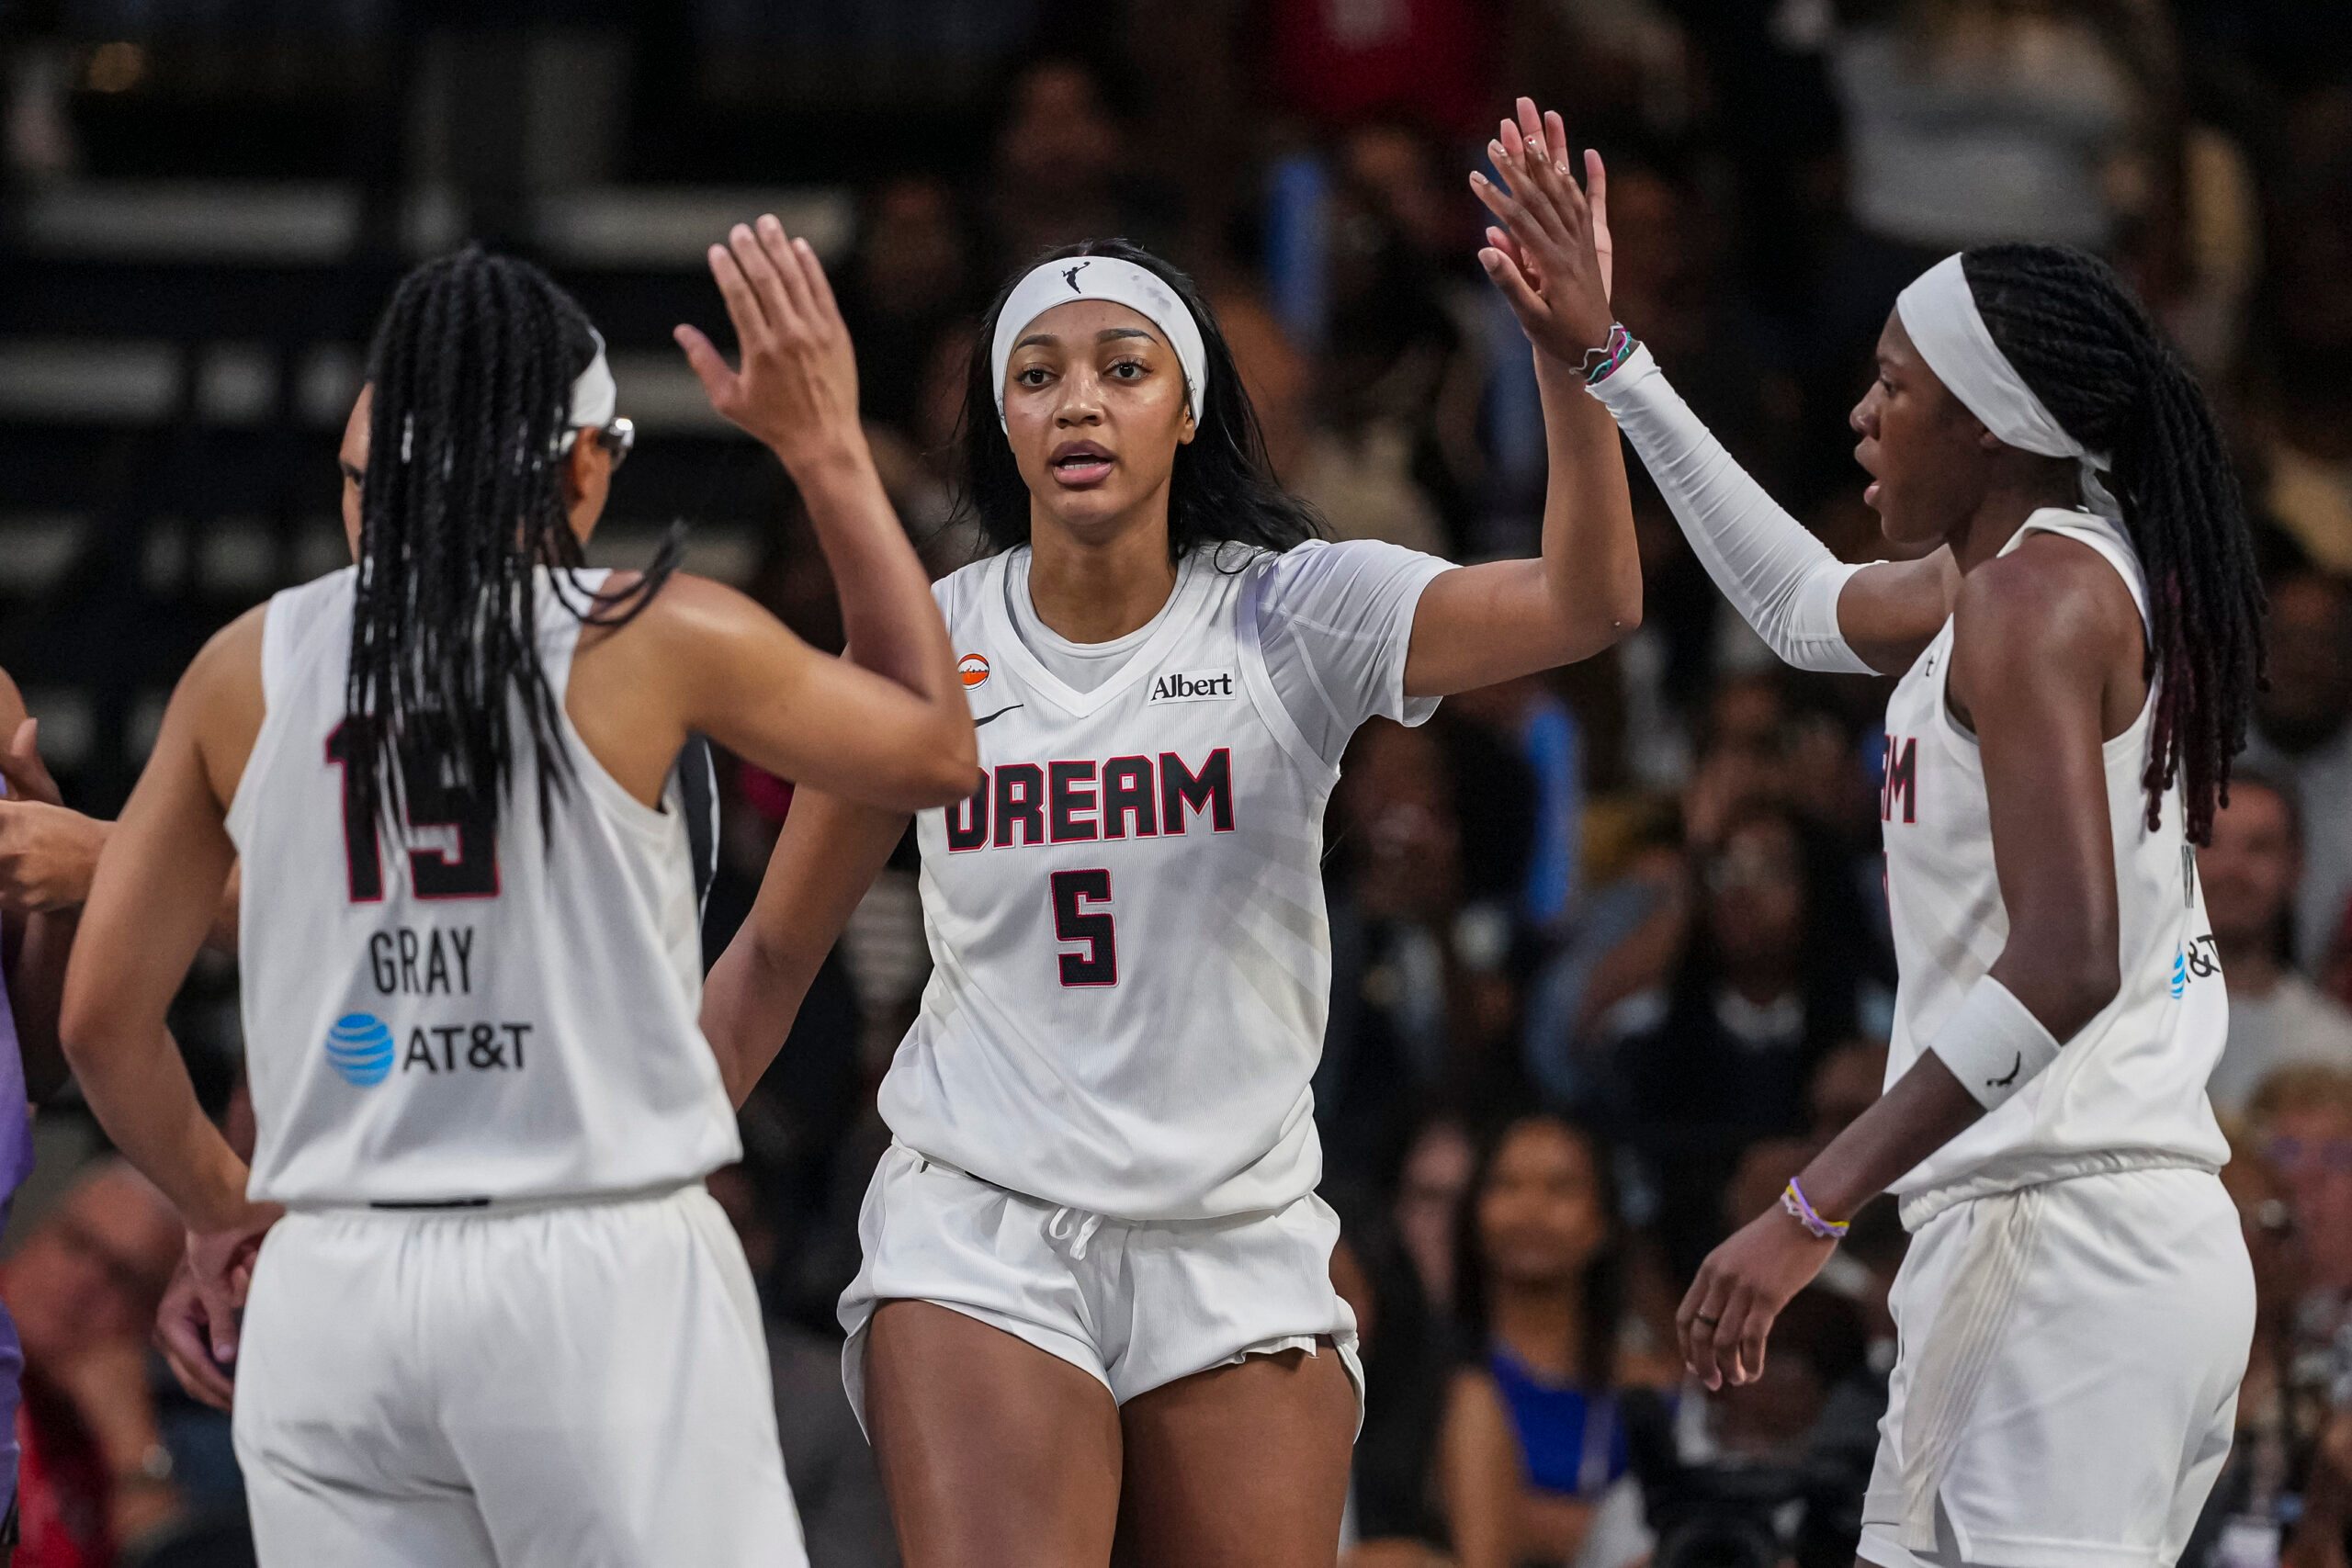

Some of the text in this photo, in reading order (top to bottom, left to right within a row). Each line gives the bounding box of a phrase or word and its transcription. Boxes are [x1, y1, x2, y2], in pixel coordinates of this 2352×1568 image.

[1150, 672, 1233, 701] Albert
[944, 747, 1236, 853] DREAM
[370, 926, 475, 995] GRAY
[1050, 868, 1119, 988] 5
[402, 1021, 533, 1074] AT&T
